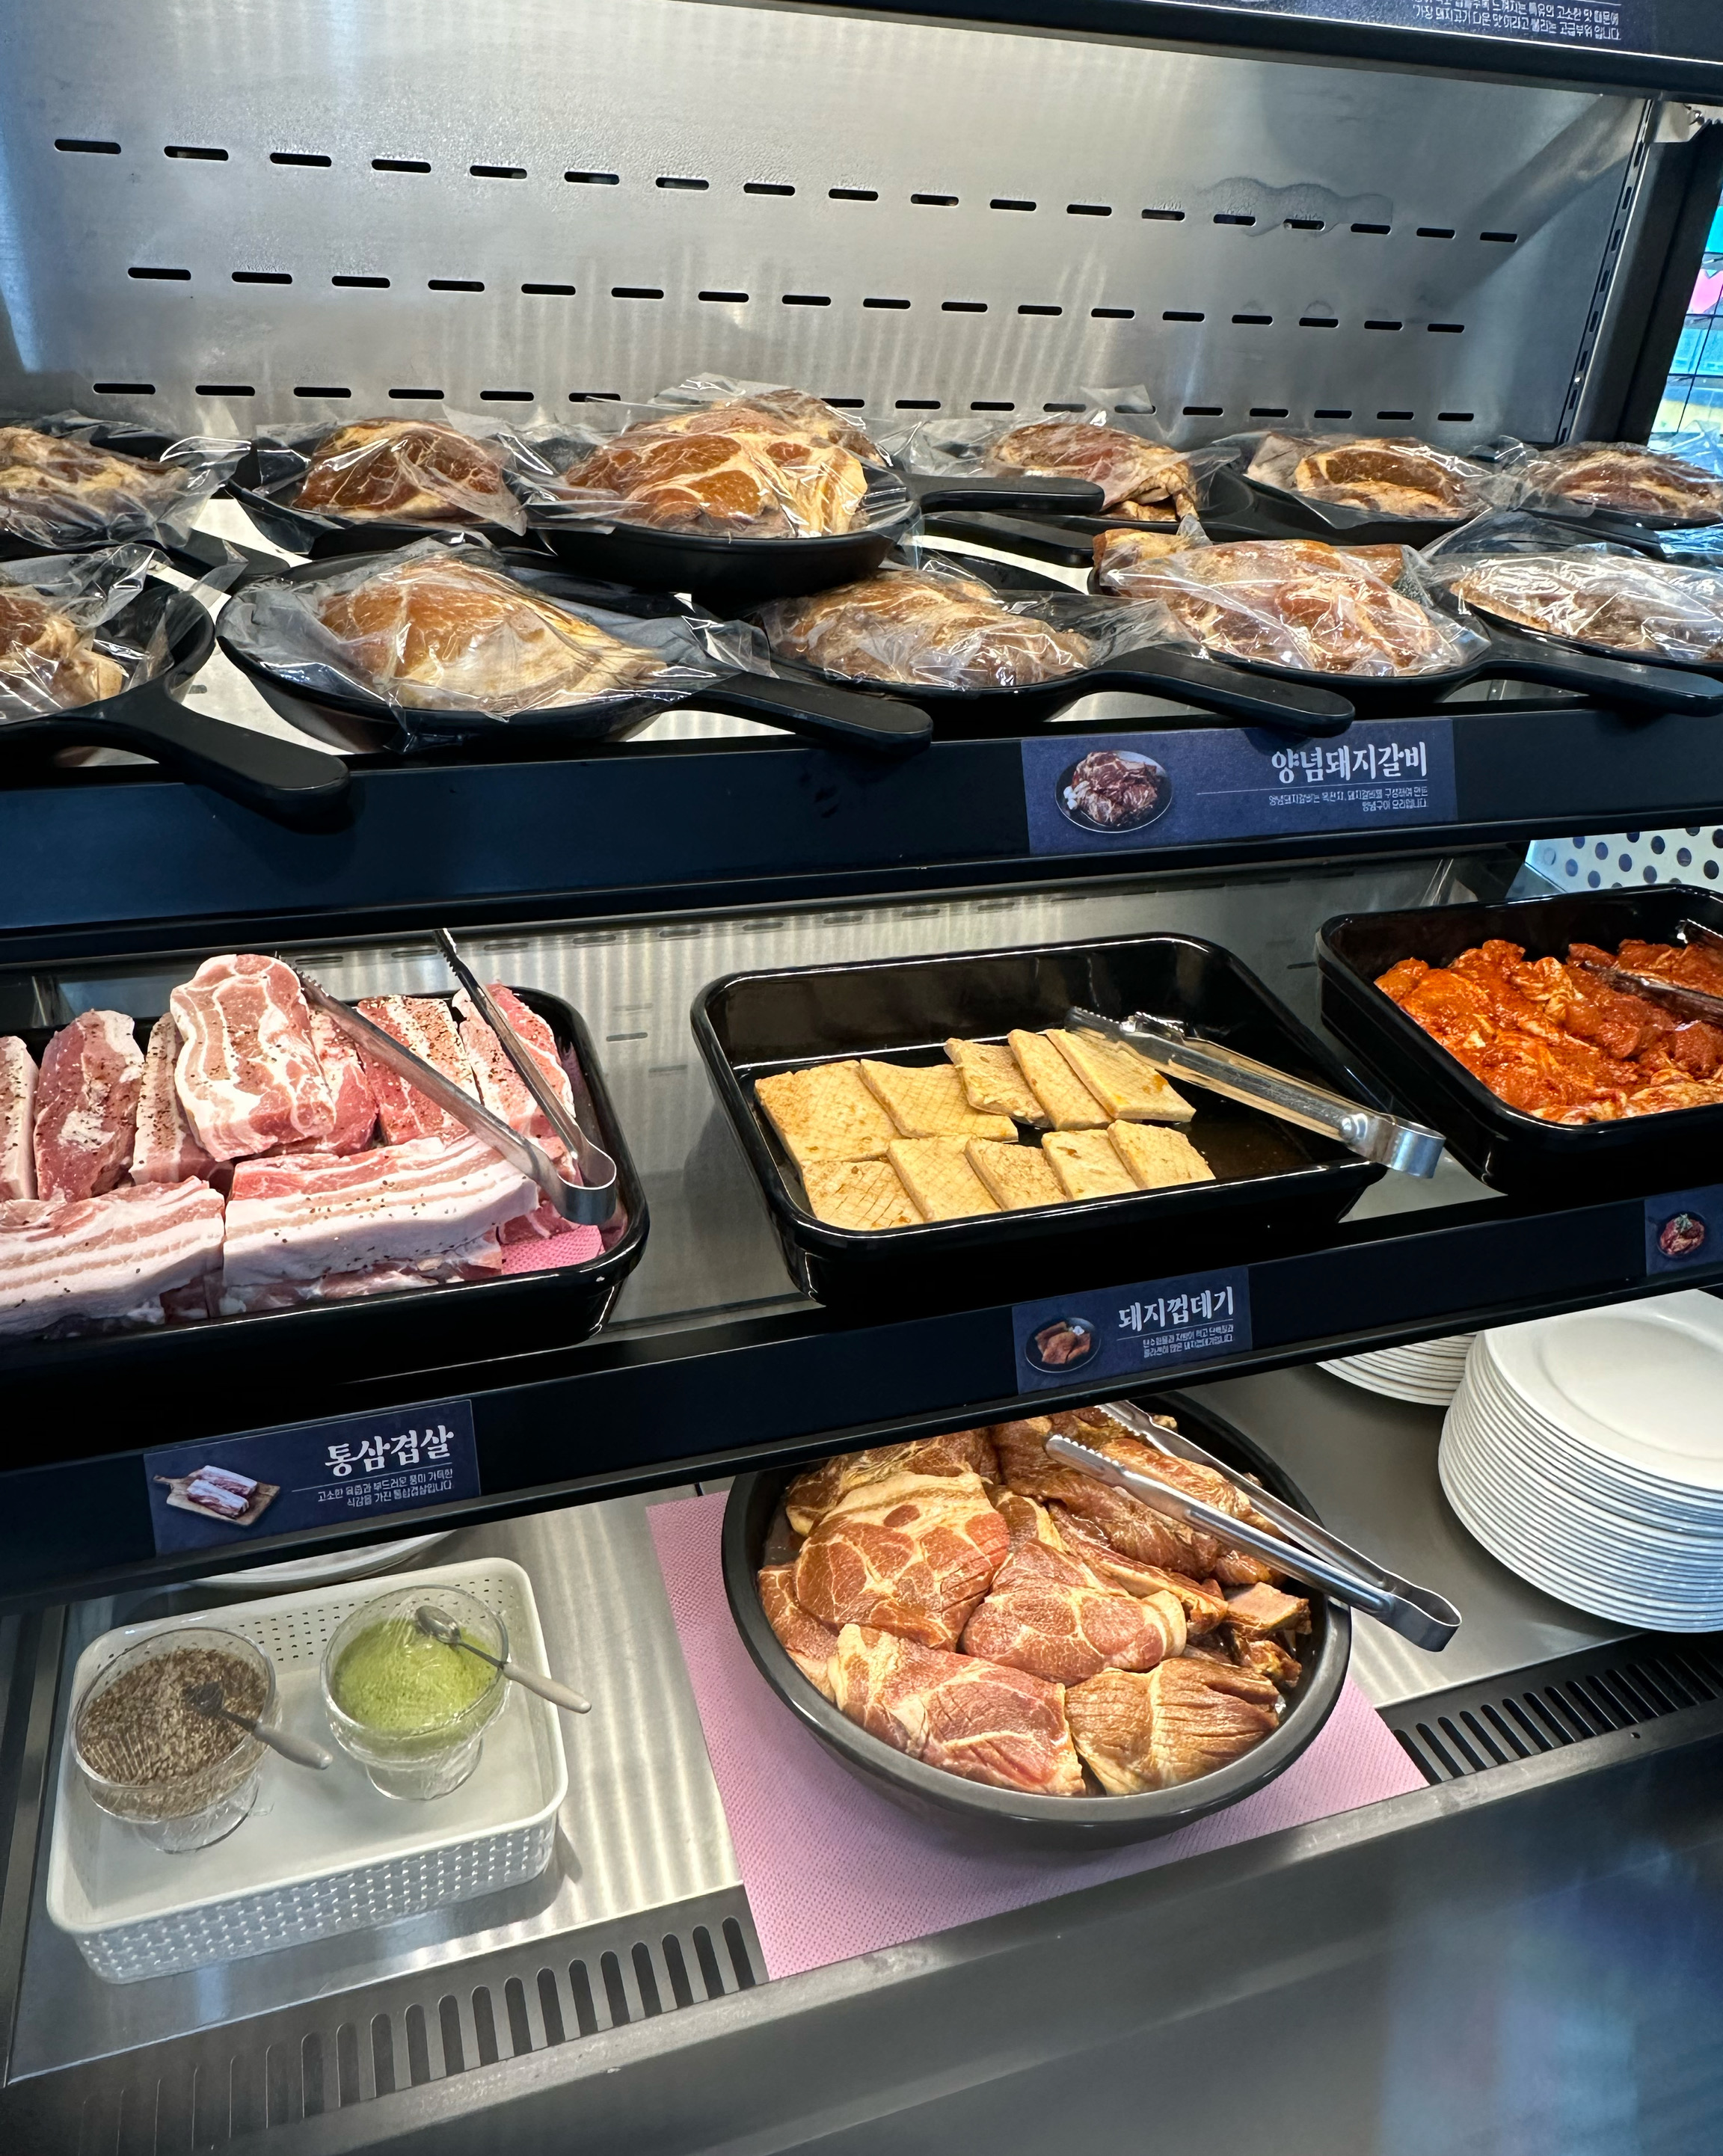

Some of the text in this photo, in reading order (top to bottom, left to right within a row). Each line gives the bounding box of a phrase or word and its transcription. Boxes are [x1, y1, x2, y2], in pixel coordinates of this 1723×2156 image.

[1413, 4, 1434, 19] 가장
[1436, 7, 1471, 24] 돼지고기
[1557, 6, 1582, 21] 고소한
[1583, 9, 1592, 22] 맛
[1594, 10, 1619, 25] 때문에
[1271, 741, 1427, 783] 양념돼지갈비
[1362, 800, 1390, 811] 양념구이
[1118, 1286, 1234, 1332] 돼지껍데기
[325, 1425, 455, 1477] 통삼겹살
[318, 1488, 343, 1502] 고소한
[373, 1476, 408, 1490] 부드러운
[409, 1473, 426, 1485] 풍미
[428, 1469, 452, 1481] 가득한
[347, 1494, 372, 1508] 식감을
[374, 1491, 392, 1502] 가진
